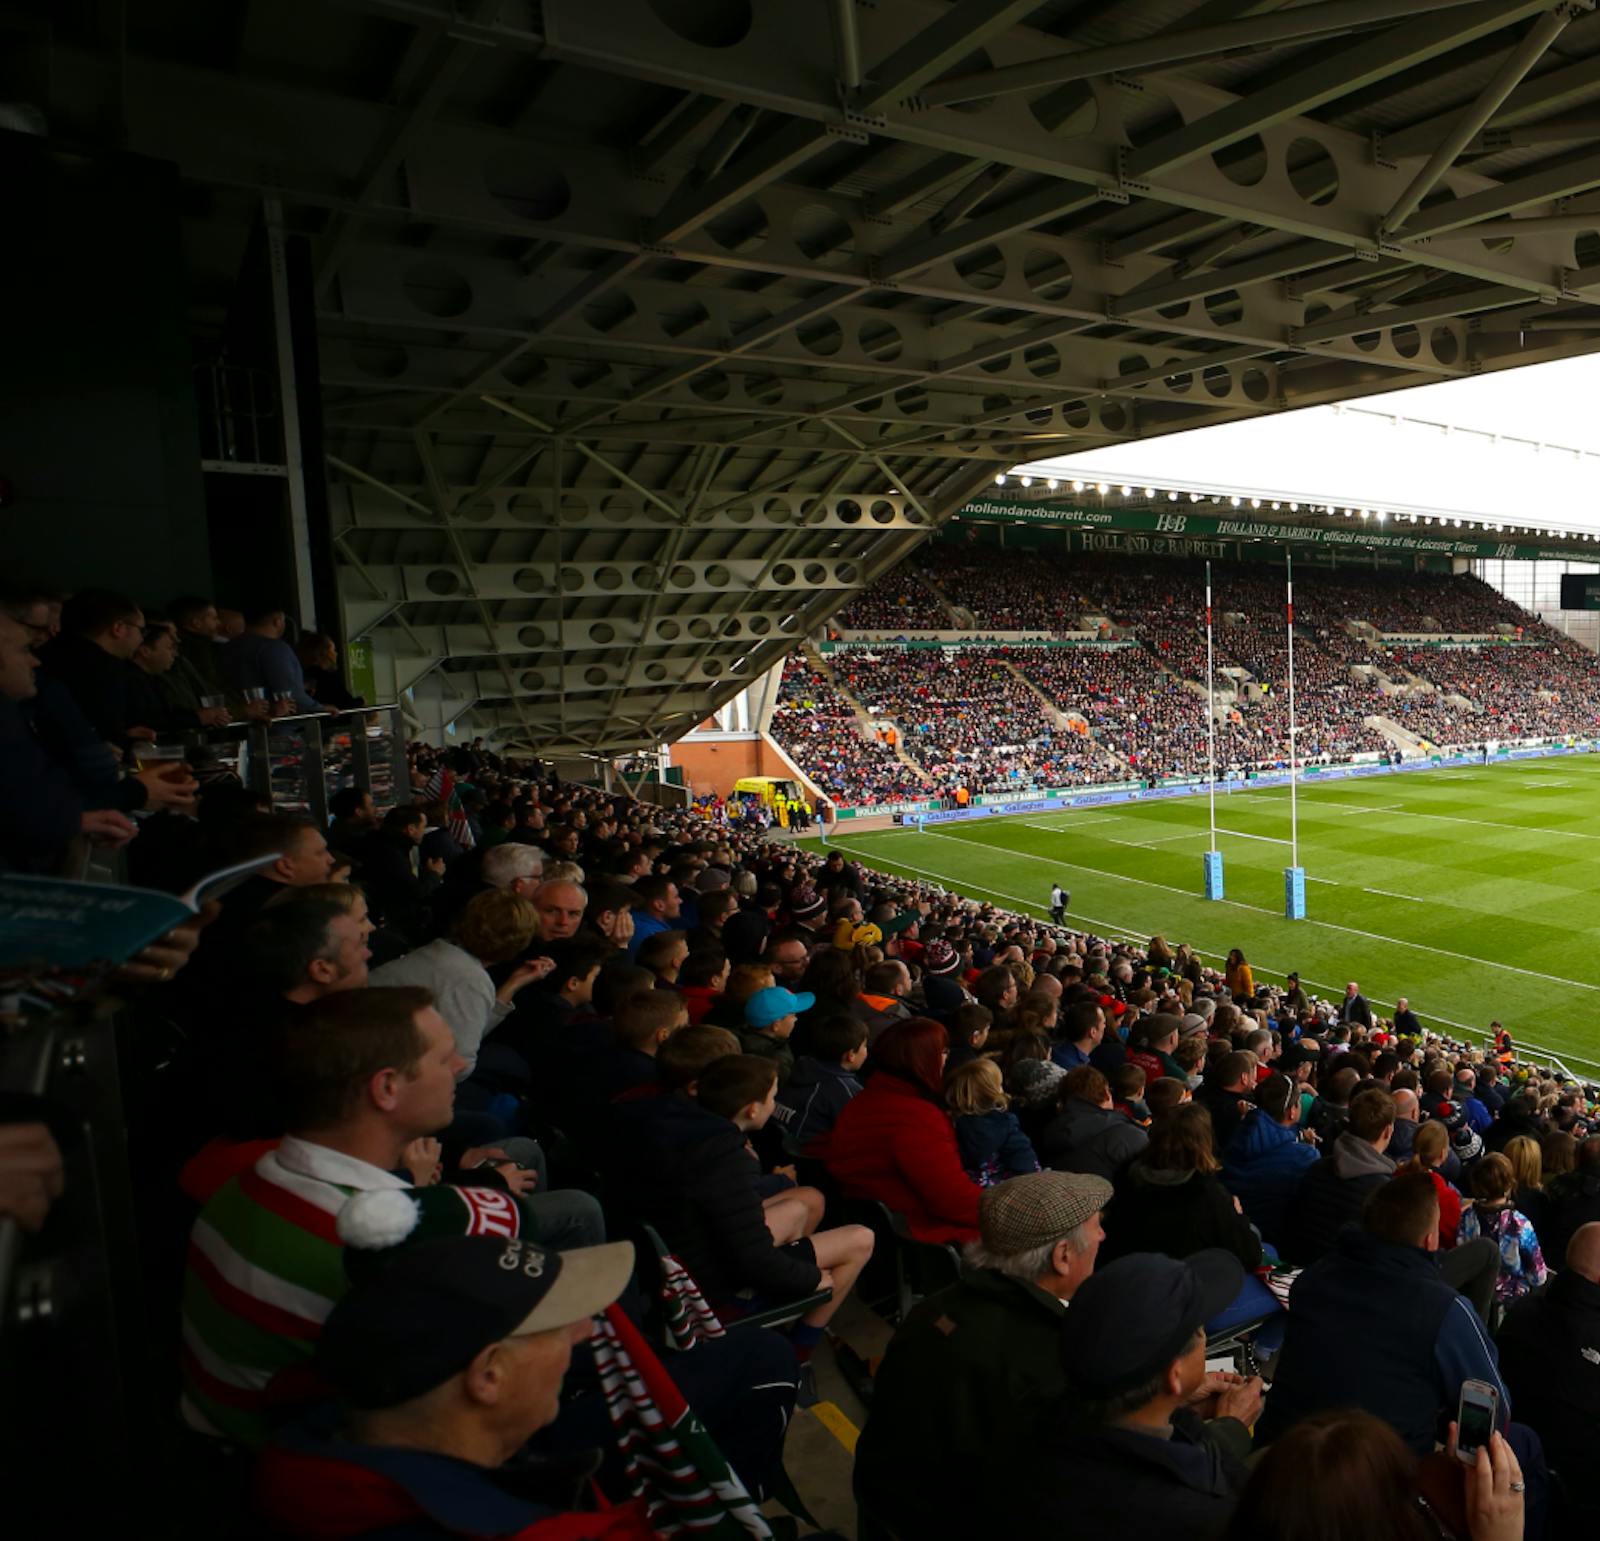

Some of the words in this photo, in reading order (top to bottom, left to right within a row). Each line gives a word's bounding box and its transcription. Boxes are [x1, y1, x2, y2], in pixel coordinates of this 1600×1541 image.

[1217, 521, 1267, 537] HOLLAND
[1279, 525, 1324, 541] BARRETT
[1081, 533, 1150, 552] HOLLAND
[1168, 539, 1227, 558] BARRETT
[927, 809, 969, 820] Gallagher
